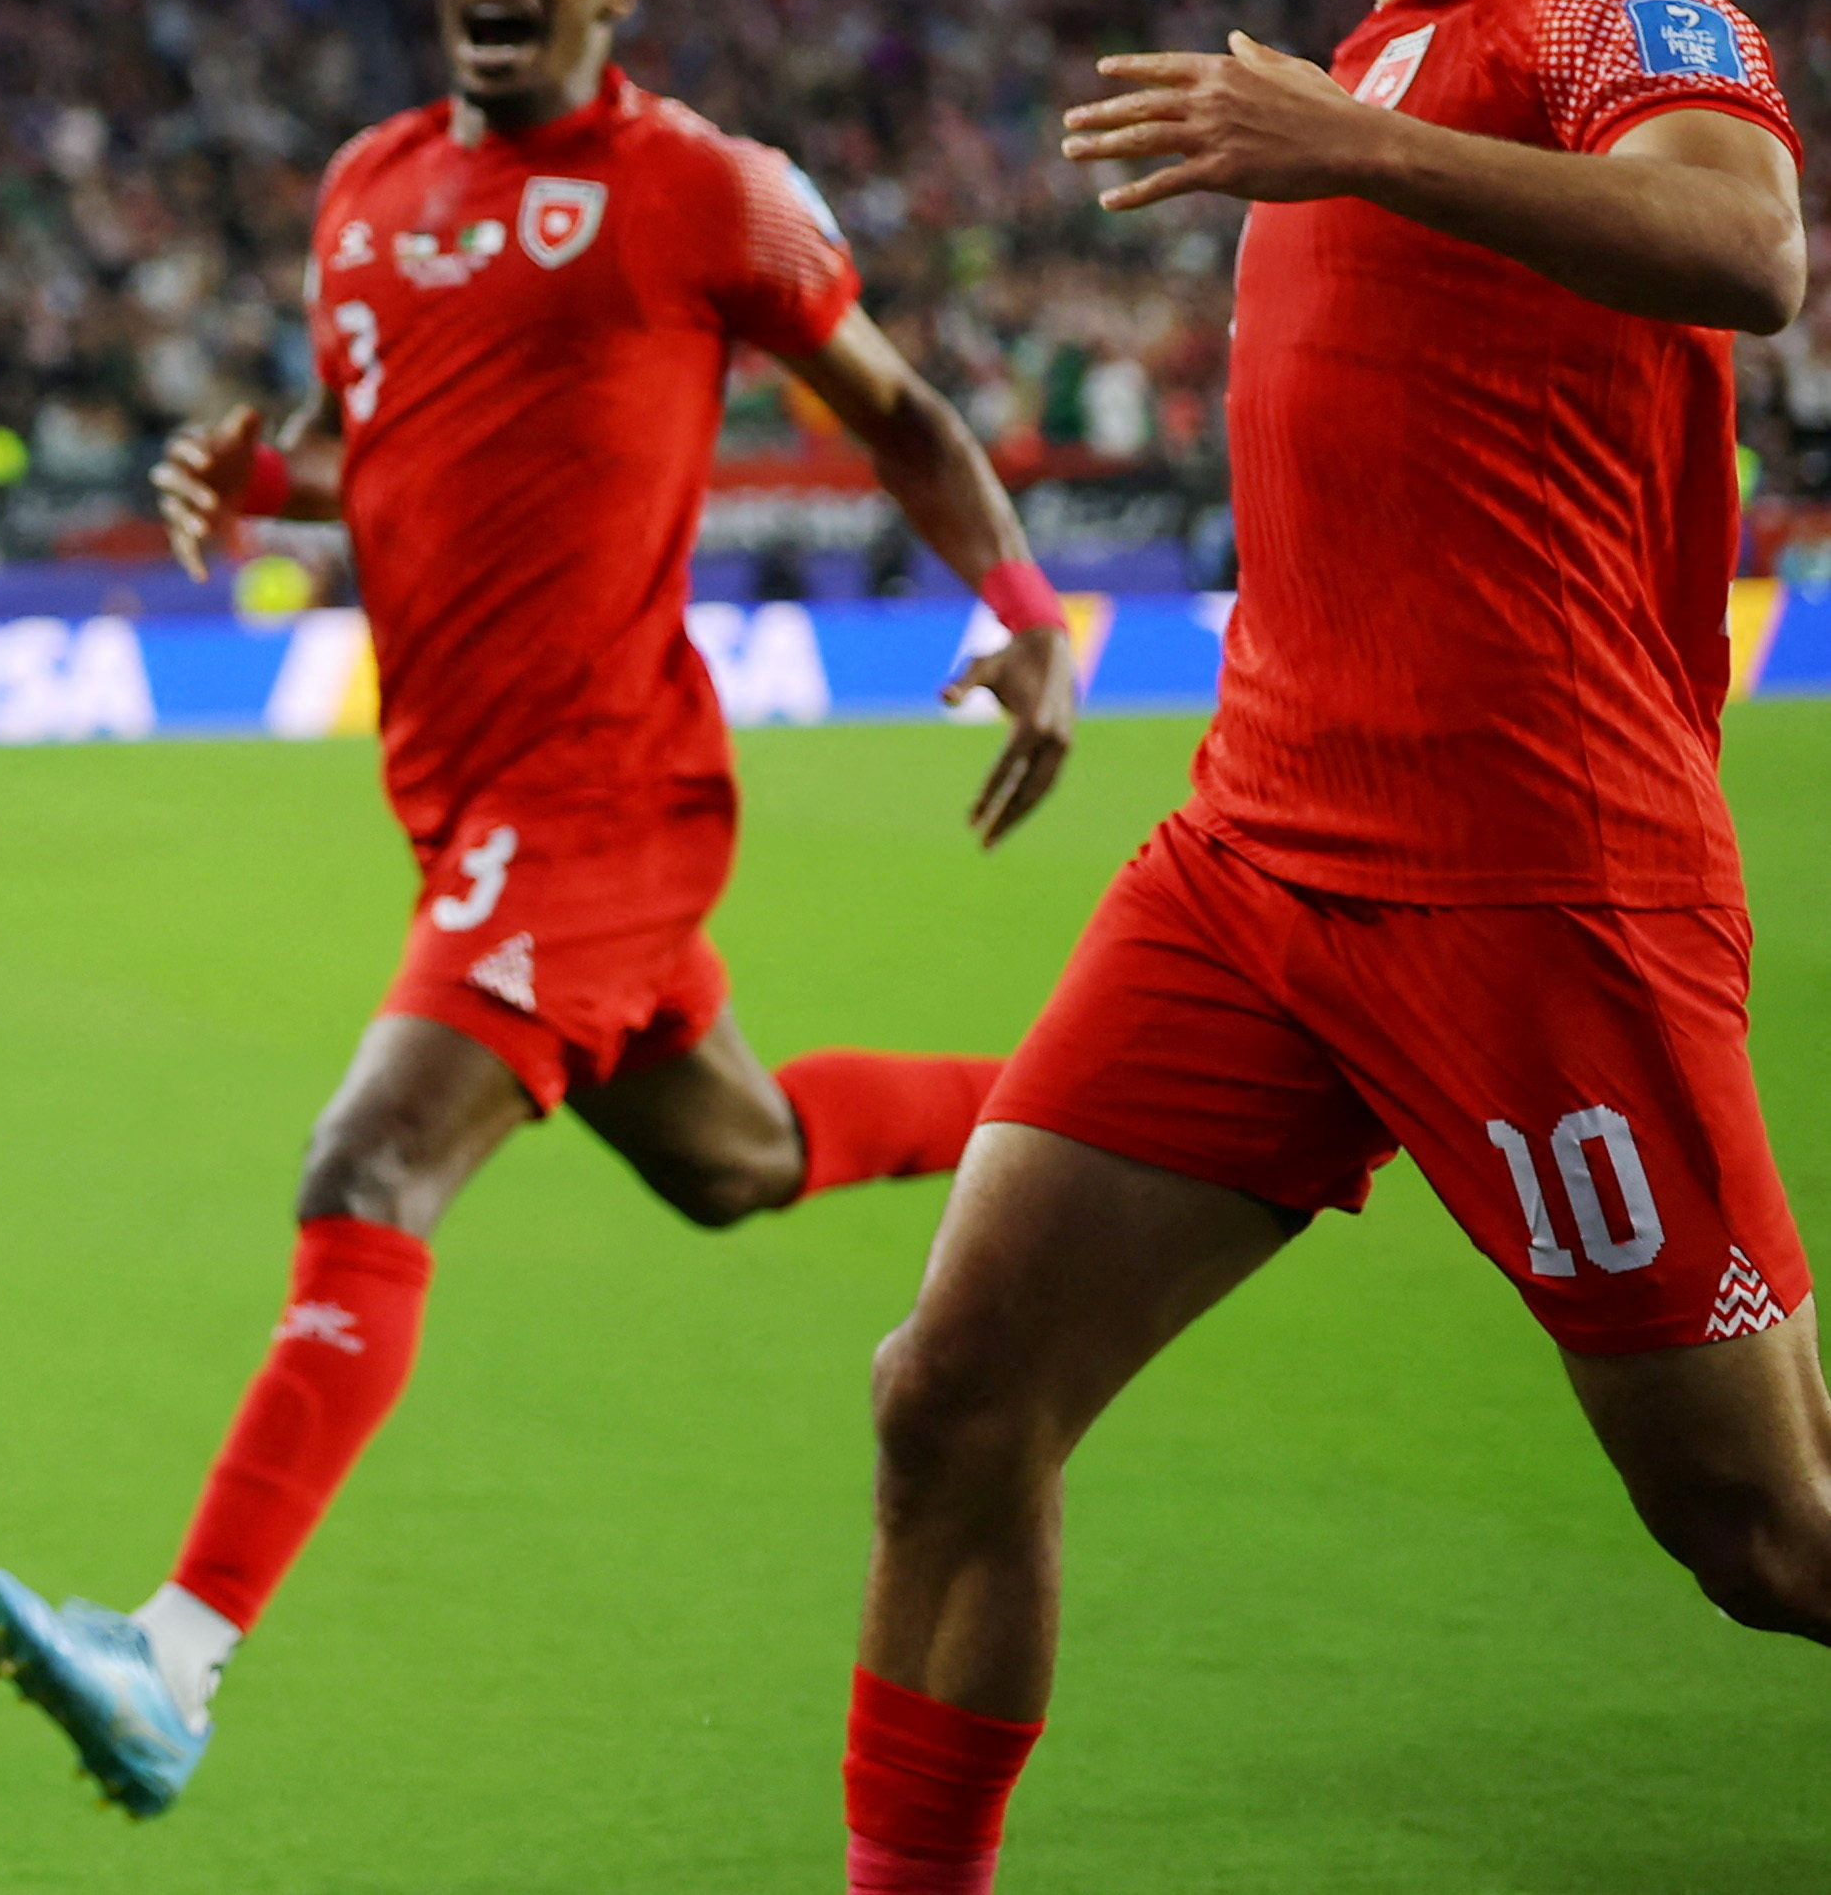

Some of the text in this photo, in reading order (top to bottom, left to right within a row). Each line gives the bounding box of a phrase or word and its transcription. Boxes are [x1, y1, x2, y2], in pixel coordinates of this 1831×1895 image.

[333, 299, 385, 423] 3
[431, 824, 519, 932] 3
[1485, 1103, 1666, 1277] 10
